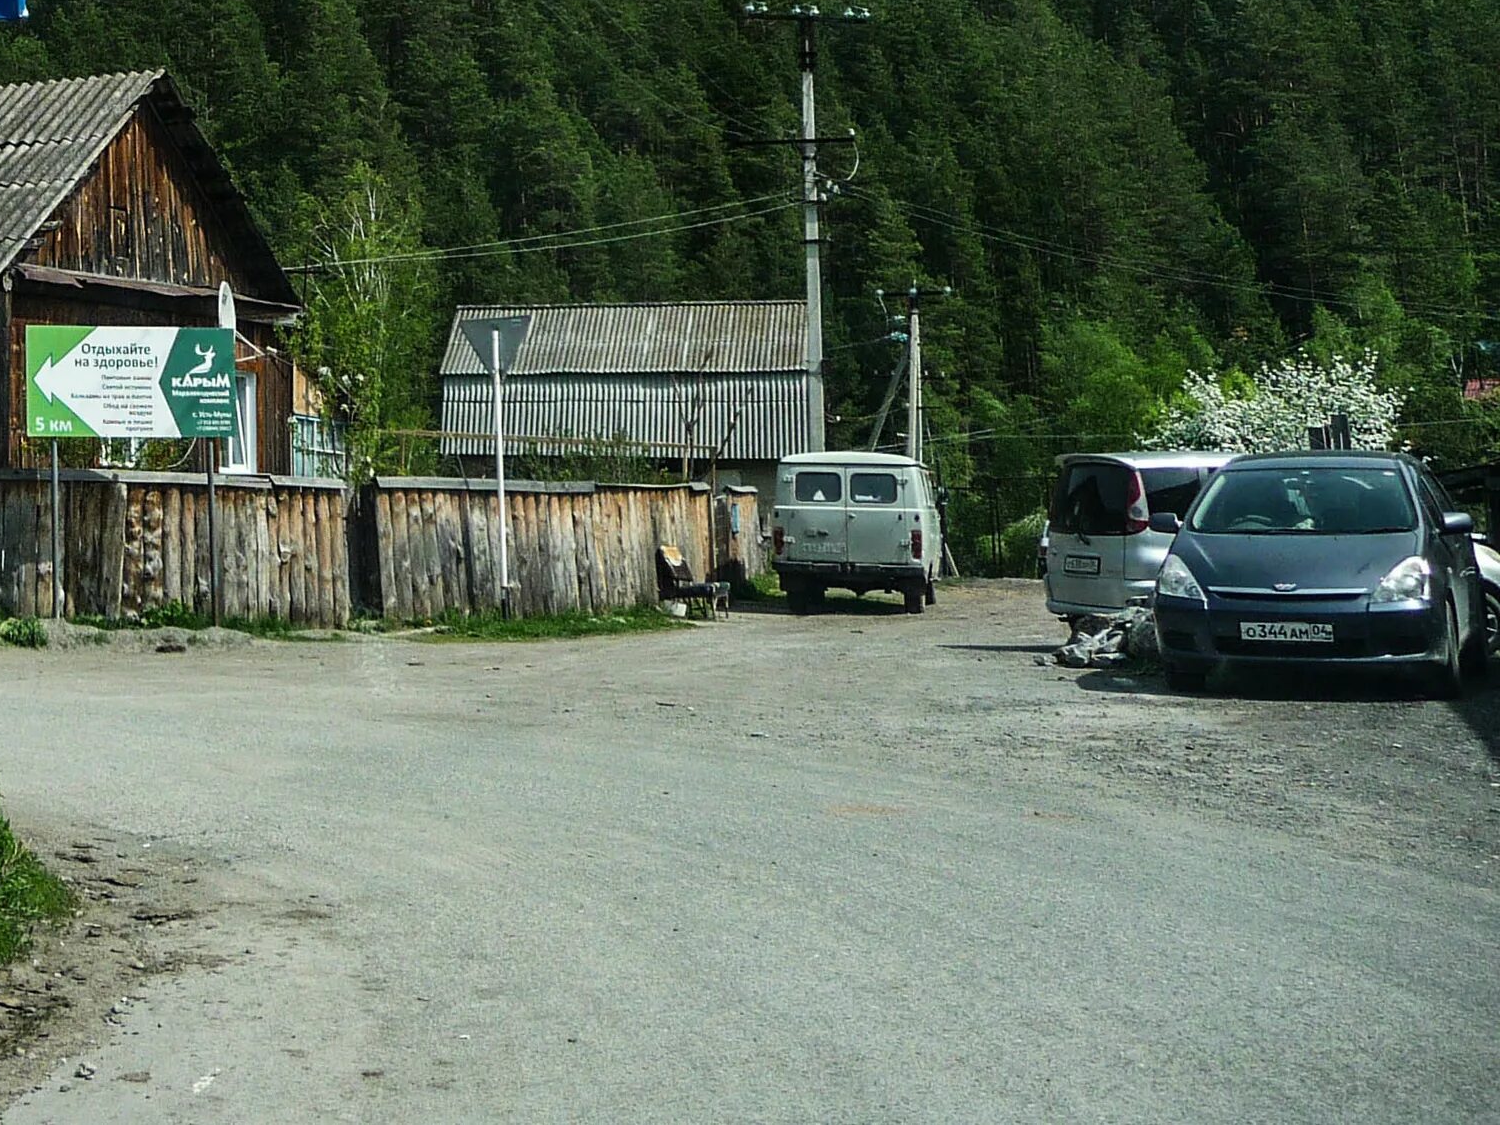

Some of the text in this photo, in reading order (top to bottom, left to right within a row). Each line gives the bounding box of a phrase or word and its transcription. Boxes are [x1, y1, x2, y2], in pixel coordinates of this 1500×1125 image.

[81, 343, 152, 356] Отдыхайте
[74, 355, 159, 370] на здоровье!
[35, 416, 45, 432] 5
